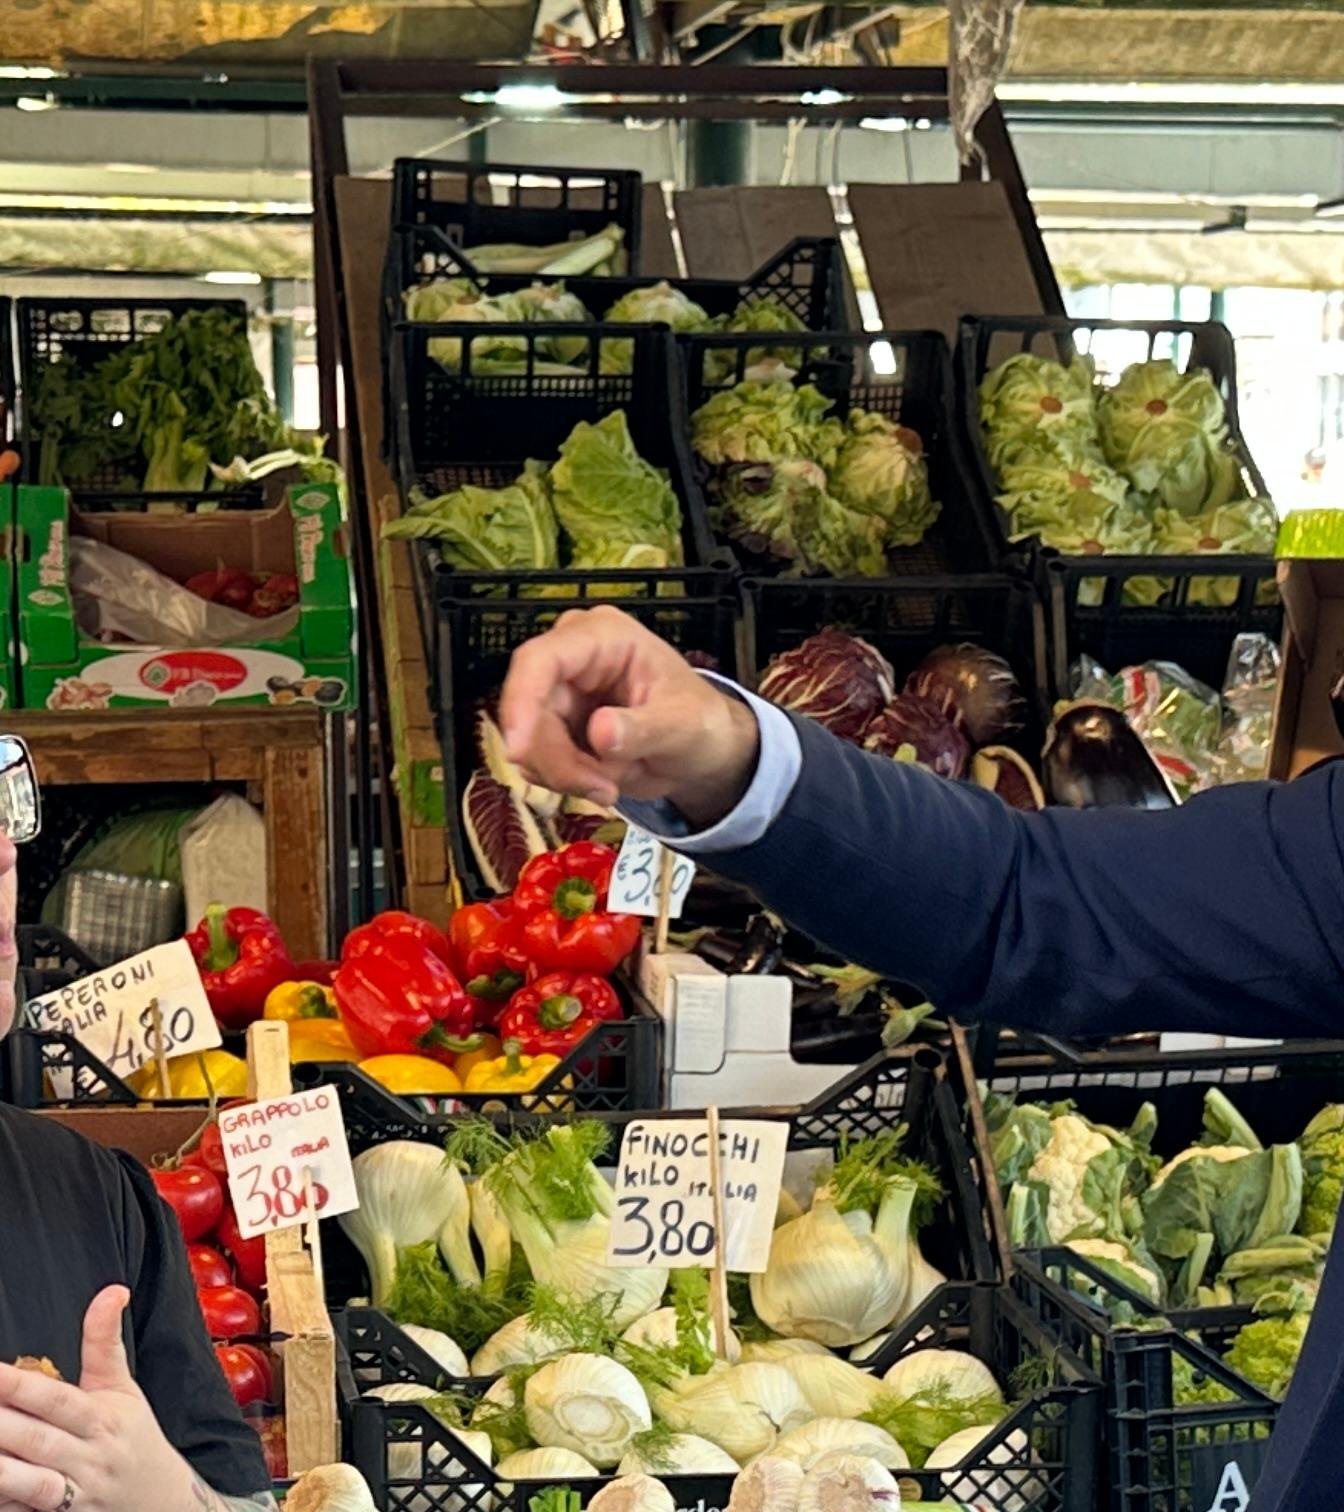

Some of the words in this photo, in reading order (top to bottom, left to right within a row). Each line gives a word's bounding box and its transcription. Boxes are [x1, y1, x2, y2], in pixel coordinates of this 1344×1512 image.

[27, 959, 155, 1029] PEPERONI
[223, 1094, 330, 1133] GRAPPOLO
[238, 1164, 329, 1227] 3,80
[613, 1196, 716, 1264] 3,80
